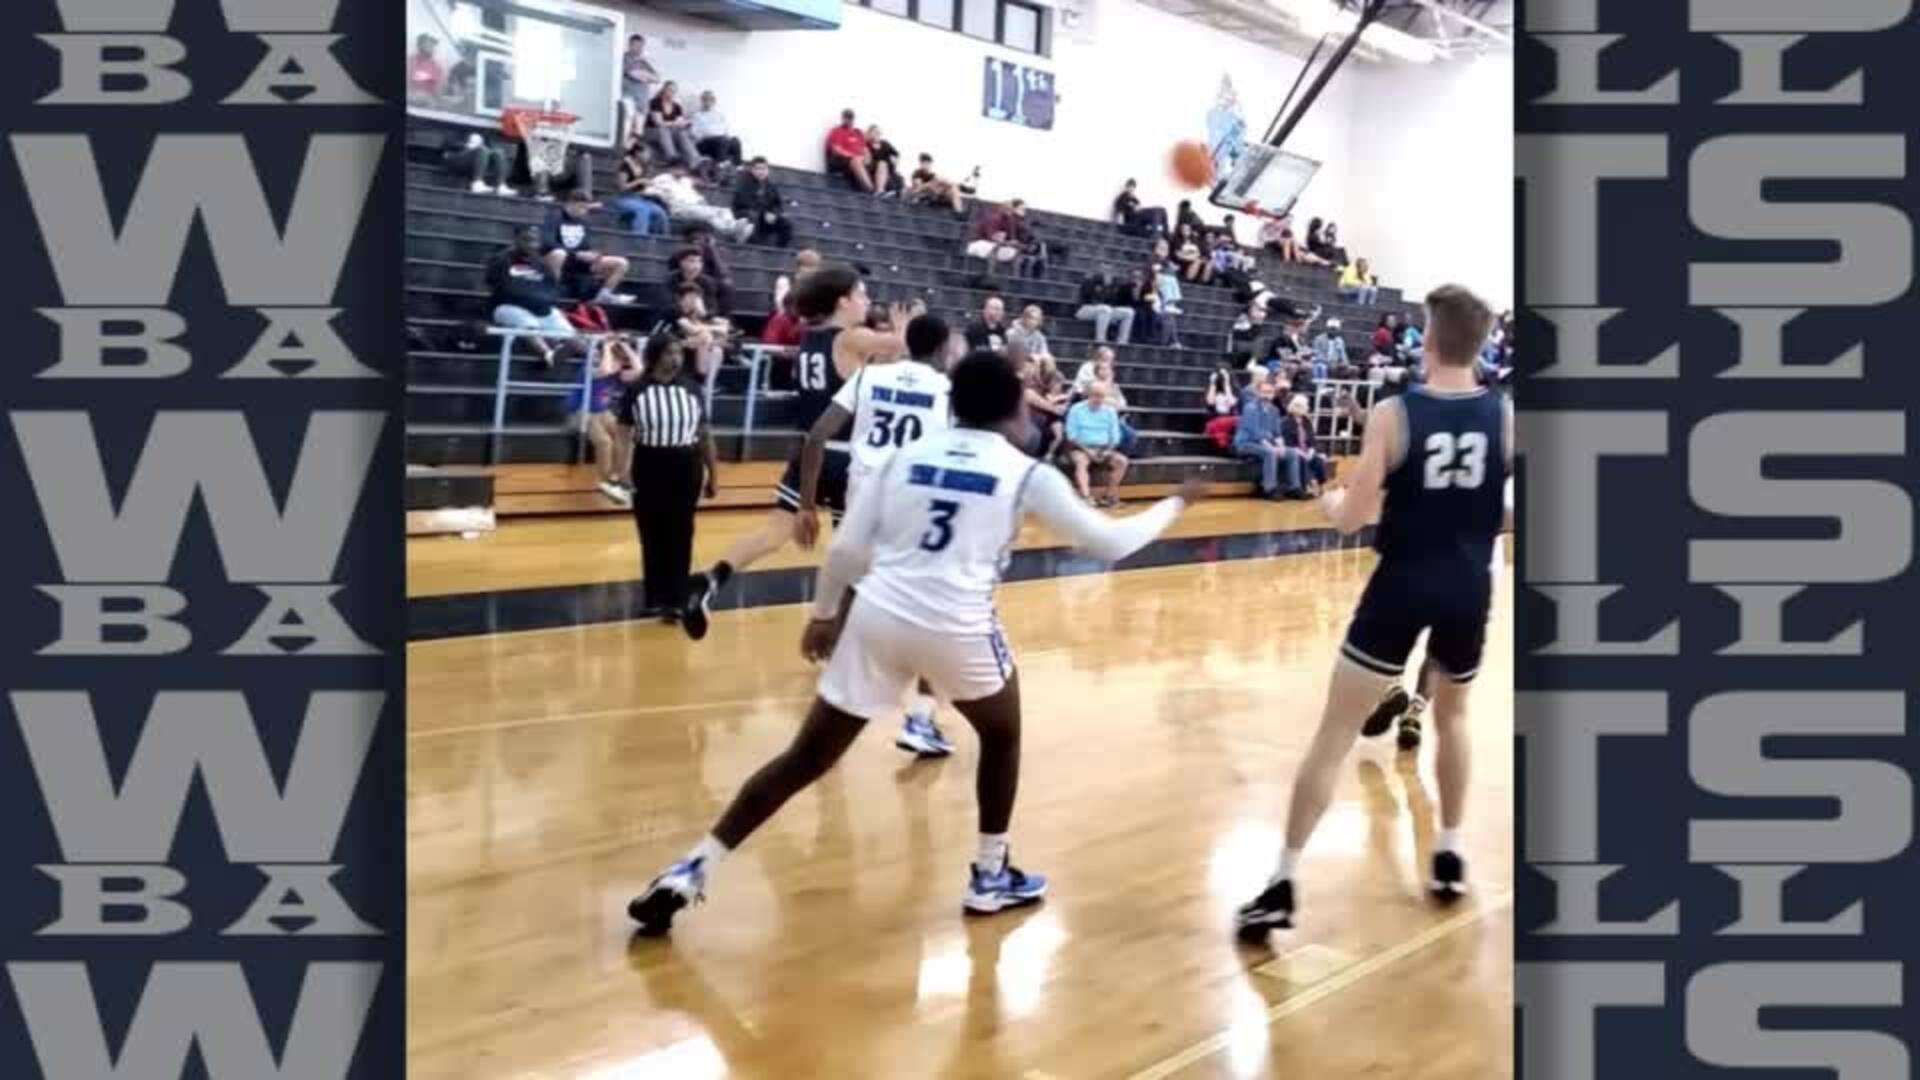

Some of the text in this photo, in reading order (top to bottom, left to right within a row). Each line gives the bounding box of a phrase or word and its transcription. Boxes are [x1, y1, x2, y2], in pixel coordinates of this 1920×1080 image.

[800, 352, 826, 390] 13
[867, 409, 923, 449] 30
[1423, 431, 1489, 490] 23
[918, 499, 961, 551] 3
